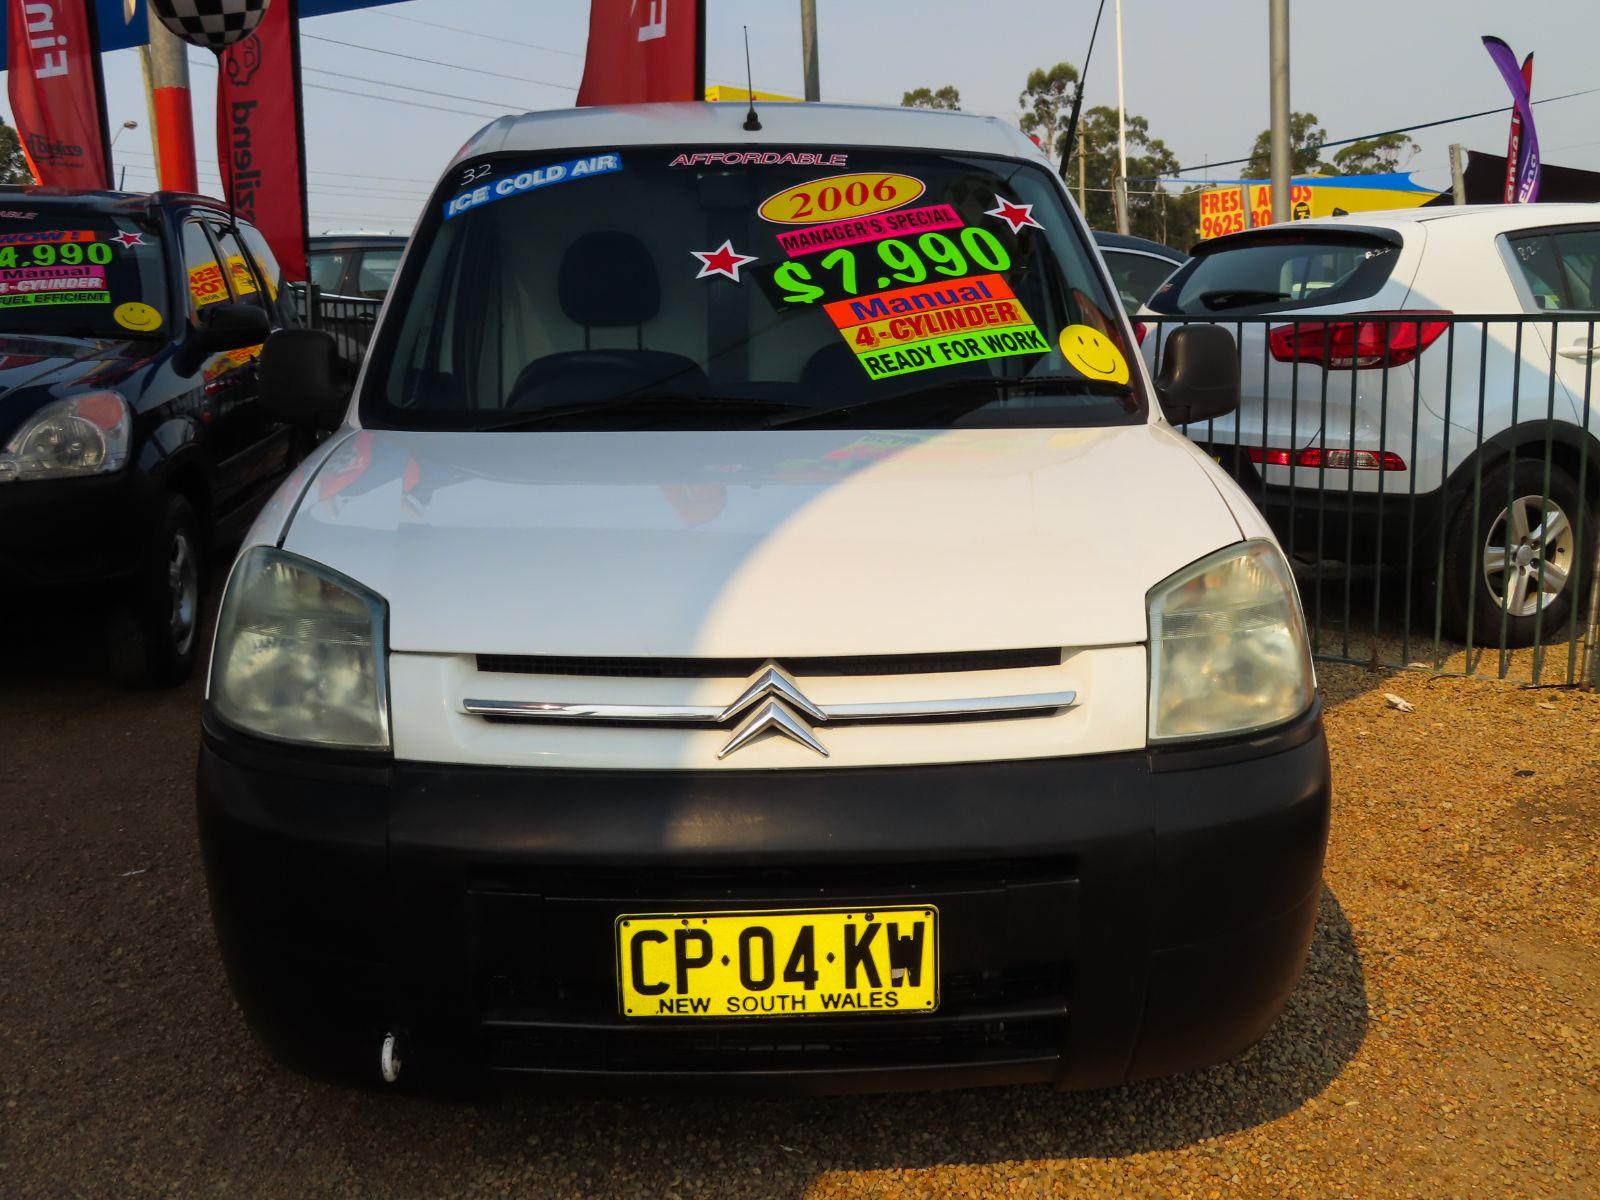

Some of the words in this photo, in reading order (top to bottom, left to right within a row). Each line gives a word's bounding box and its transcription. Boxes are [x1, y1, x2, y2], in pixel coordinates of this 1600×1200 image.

[668, 152, 849, 167] AFFORDABLE
[448, 186, 491, 216] ICE
[495, 165, 568, 196] COLD
[571, 155, 619, 177] AIR
[460, 163, 493, 186] 32
[788, 176, 897, 219] 2006
[1257, 186, 1313, 208] AOS
[781, 218, 884, 253] MANAGER'S
[888, 208, 955, 233] SPECIAL
[1202, 212, 1244, 237] 9625
[2, 267, 92, 280] Manual
[34, 292, 106, 304] EFFICIENT
[850, 280, 993, 321] Manual
[855, 301, 1020, 347] 4-CYLINDER
[864, 345, 937, 376] READY
[937, 337, 983, 361] FOR
[981, 329, 1047, 353] WORK
[658, 997, 711, 1014] NEW
[727, 995, 806, 1012] SOUTH
[821, 991, 899, 1009] WALES
